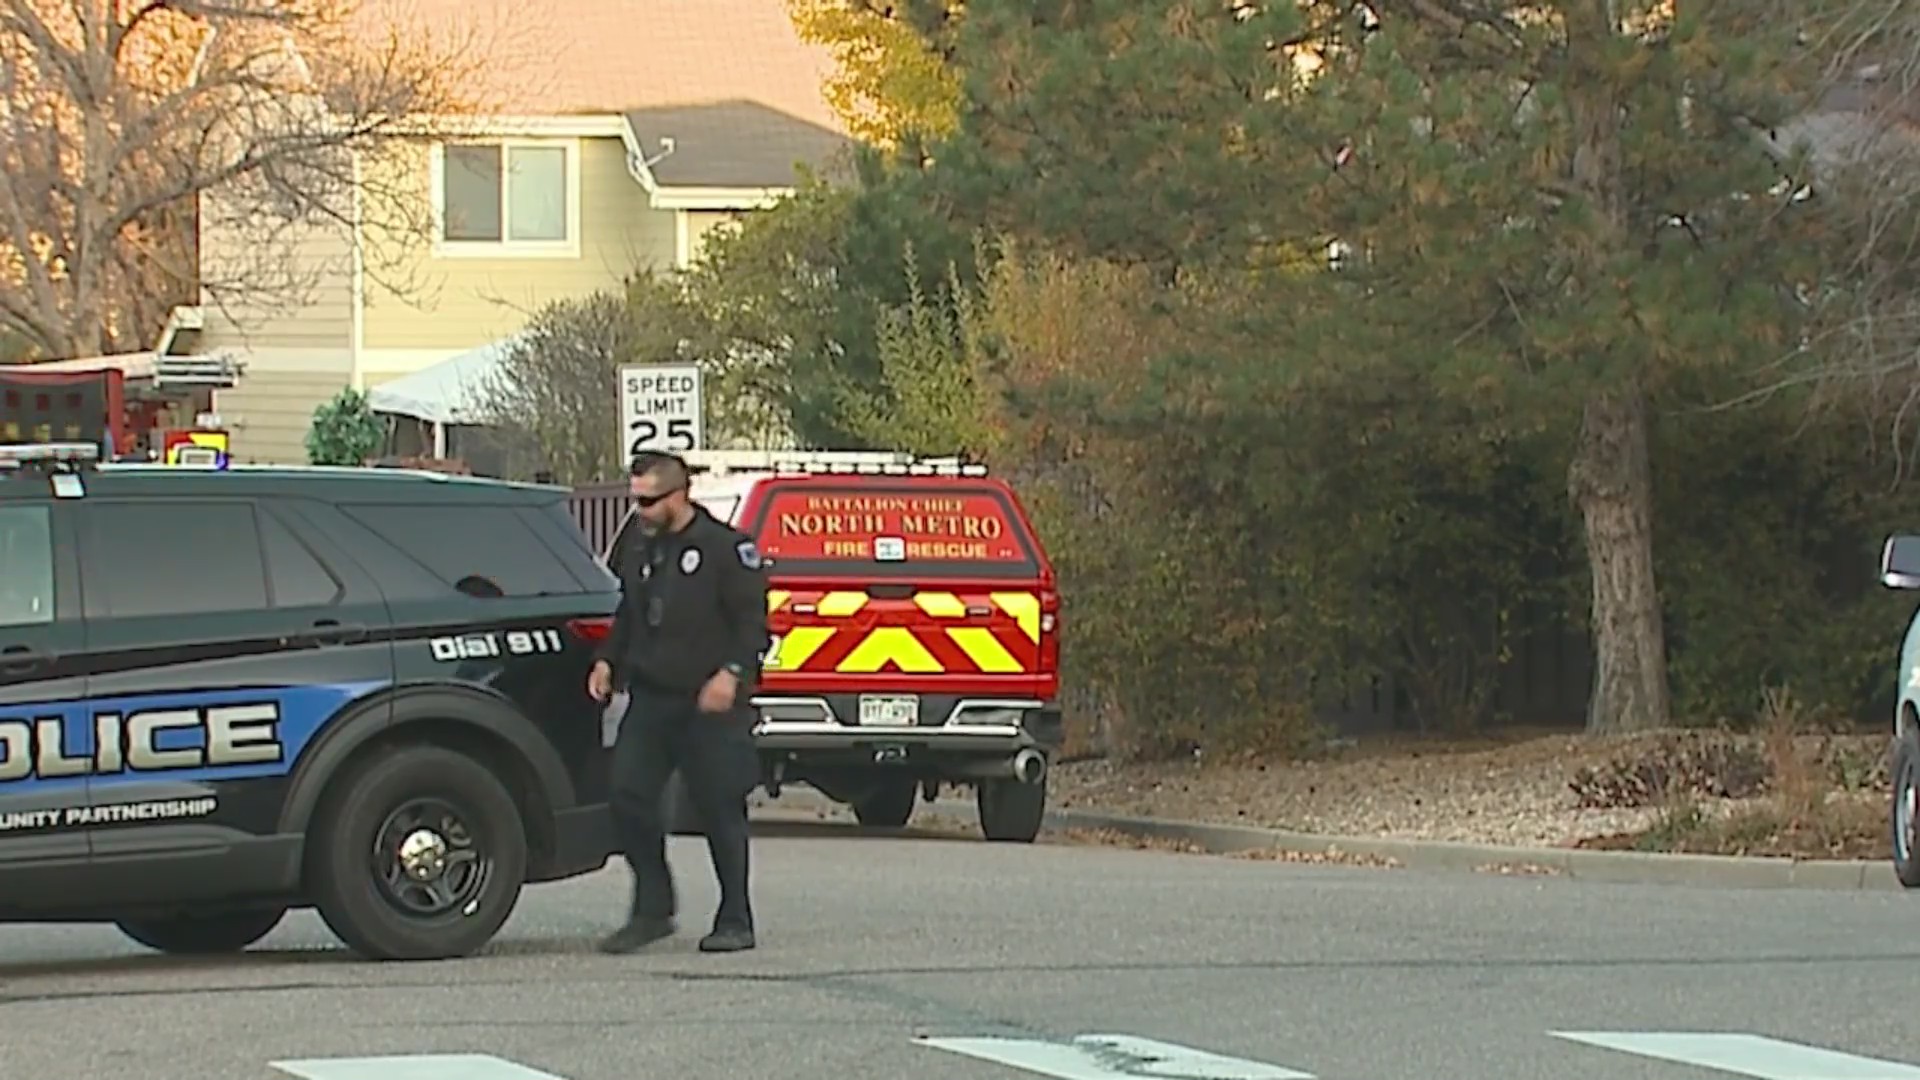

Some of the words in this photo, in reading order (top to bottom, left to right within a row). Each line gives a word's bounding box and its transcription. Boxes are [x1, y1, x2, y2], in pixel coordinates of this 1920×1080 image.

[627, 376, 694, 394] SPEED
[633, 398, 687, 415] LIMIT
[630, 419, 695, 455] 25
[807, 496, 907, 511] BATTALION
[910, 499, 963, 513] CHIEF
[781, 513, 884, 537] NORTH
[902, 515, 1001, 539] METRO
[823, 541, 869, 557] FIRE
[906, 542, 987, 558] RESCUE
[430, 633, 500, 660] Dial
[506, 629, 562, 654] 911
[66, 798, 216, 825] PARTNERSHIP
